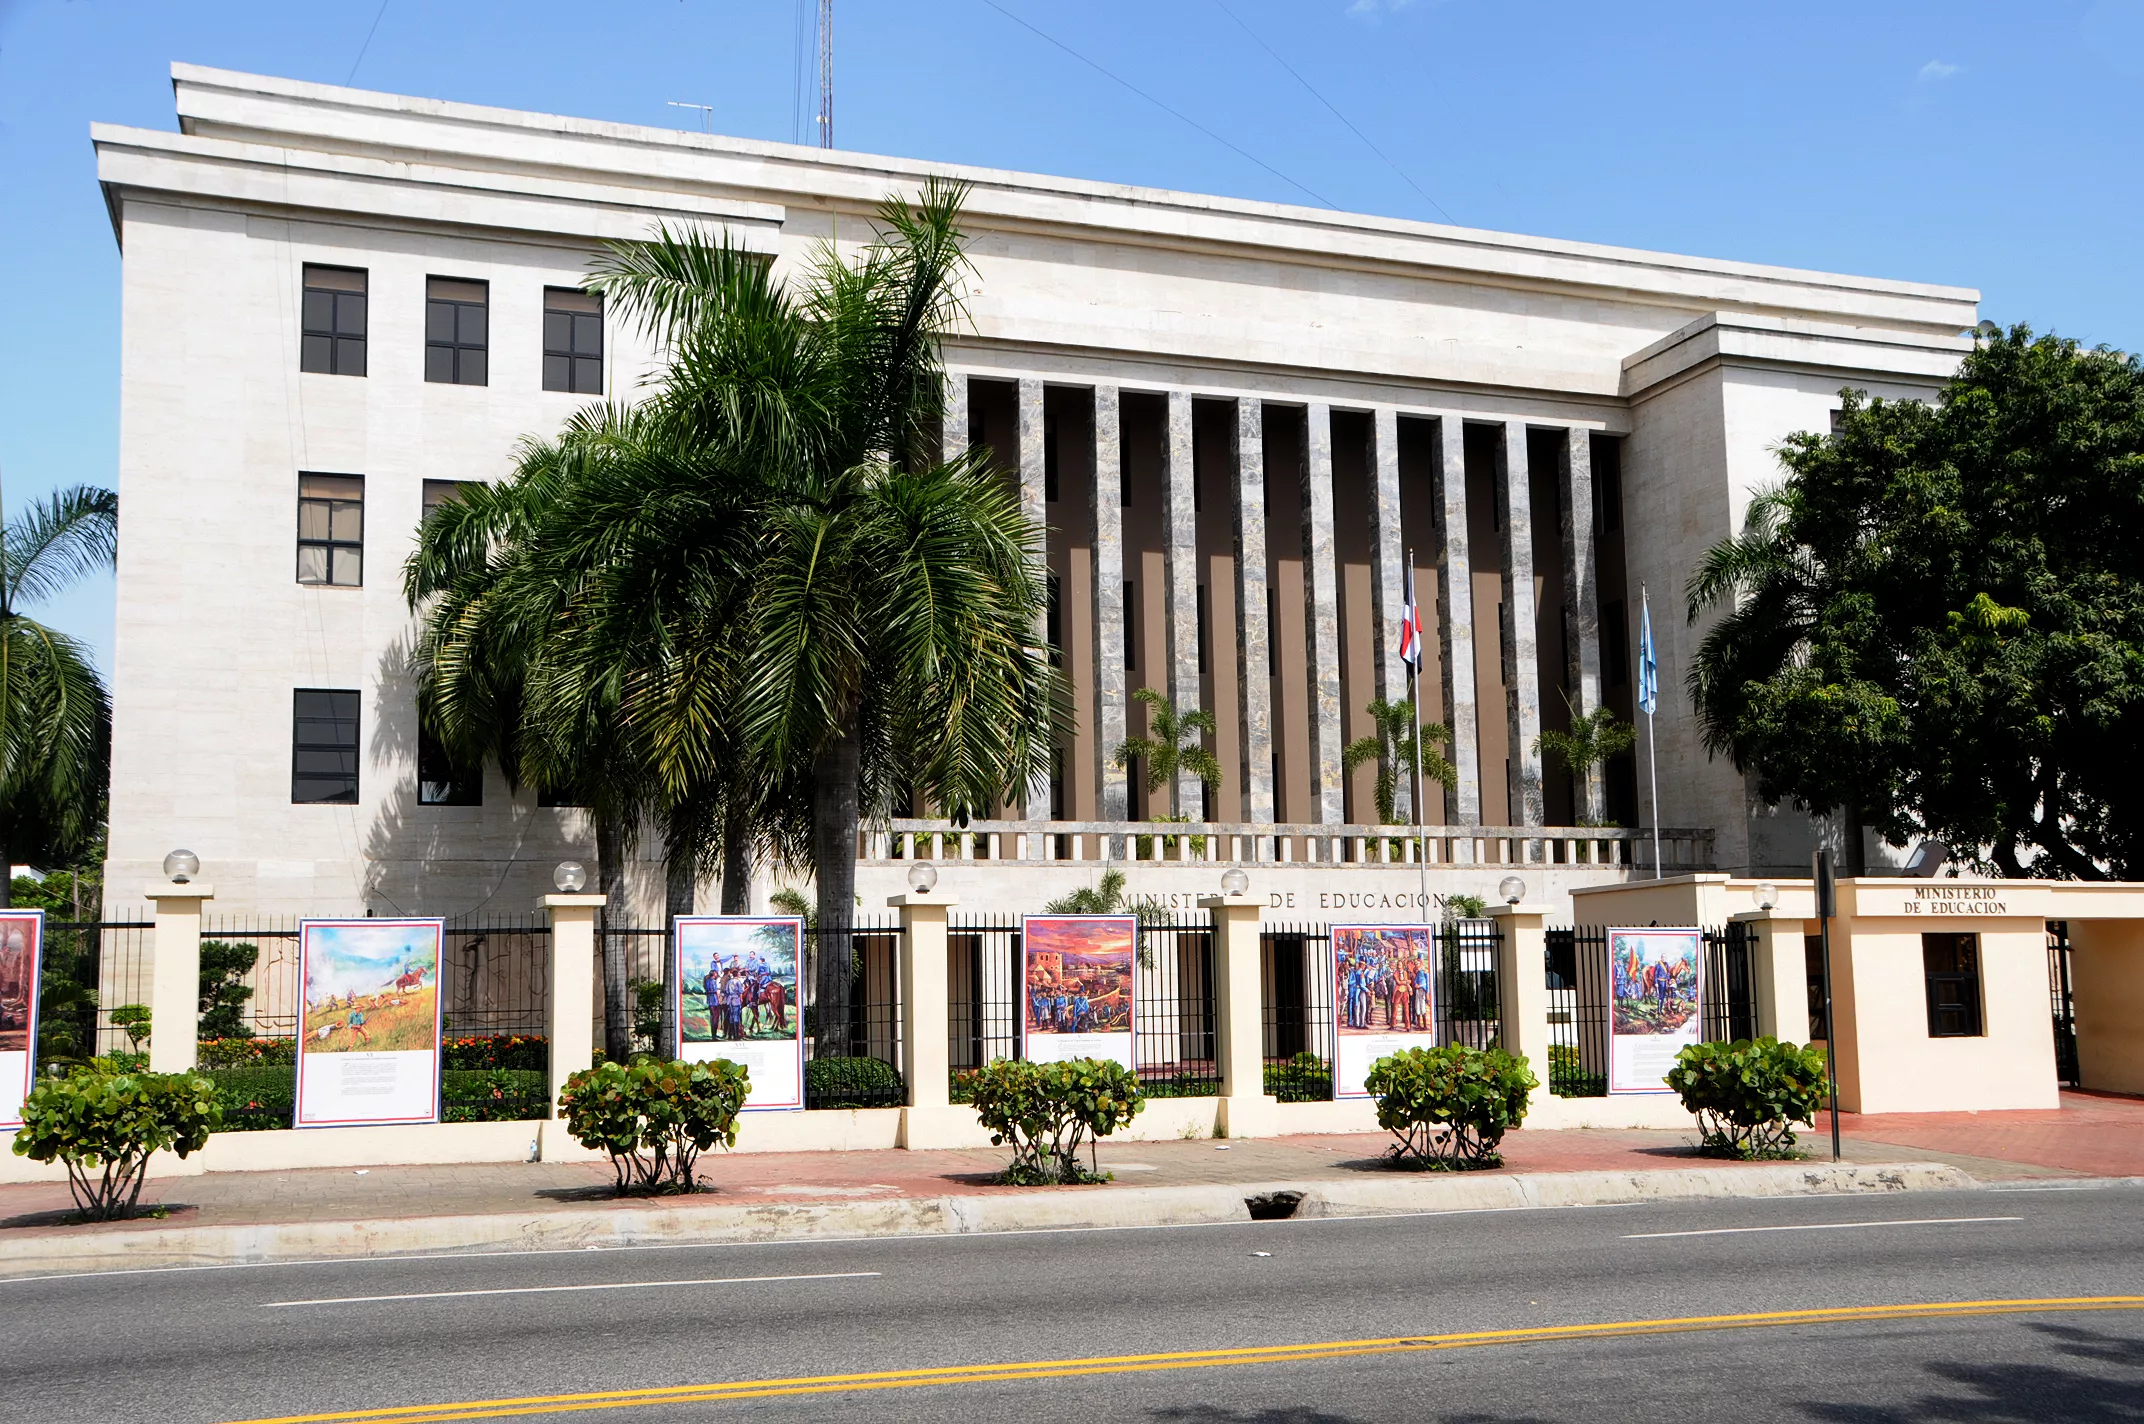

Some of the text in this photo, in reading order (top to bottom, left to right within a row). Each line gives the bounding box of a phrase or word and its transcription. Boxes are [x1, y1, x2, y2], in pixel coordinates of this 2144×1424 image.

[1914, 887, 1996, 899] MINISTERIO
[1118, 893, 1445, 908] MINIST DE EDUCACION
[1904, 902, 2006, 914] DE EDUCACION
